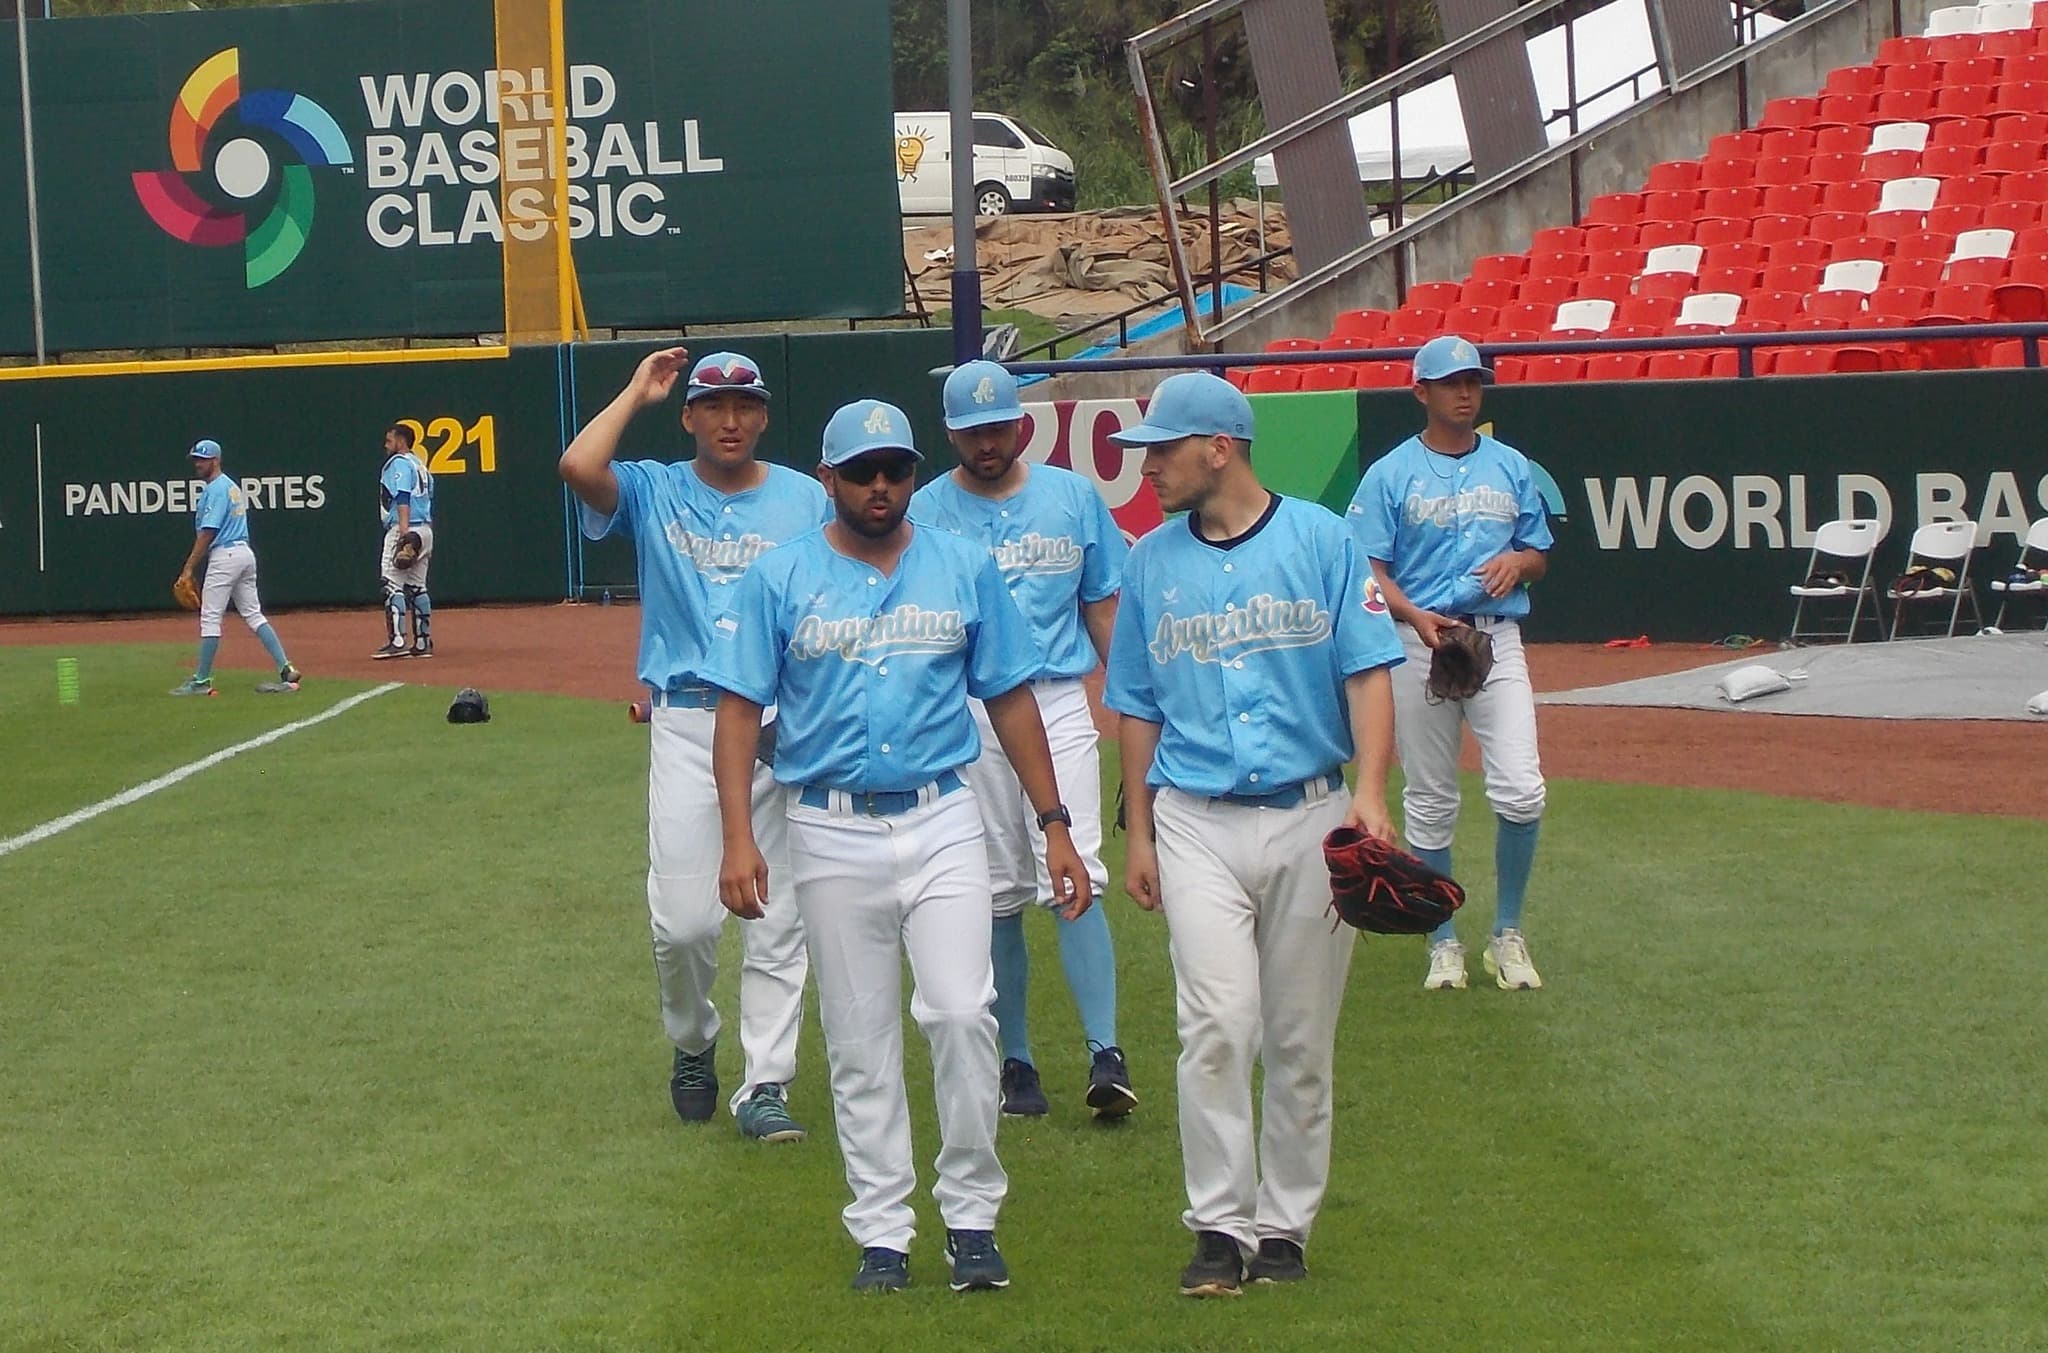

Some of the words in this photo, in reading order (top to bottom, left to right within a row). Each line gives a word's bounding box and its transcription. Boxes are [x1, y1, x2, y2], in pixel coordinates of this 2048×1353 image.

[360, 64, 616, 129] WORLD
[365, 119, 724, 189] BASEBALL
[366, 181, 667, 248] CLASSIC
[64, 474, 326, 516] PANDEPRTES
[1584, 474, 1893, 549] WORLD
[1916, 471, 2048, 548] BA
[789, 604, 968, 665] Argentina
[1149, 594, 1332, 666] Argentina
